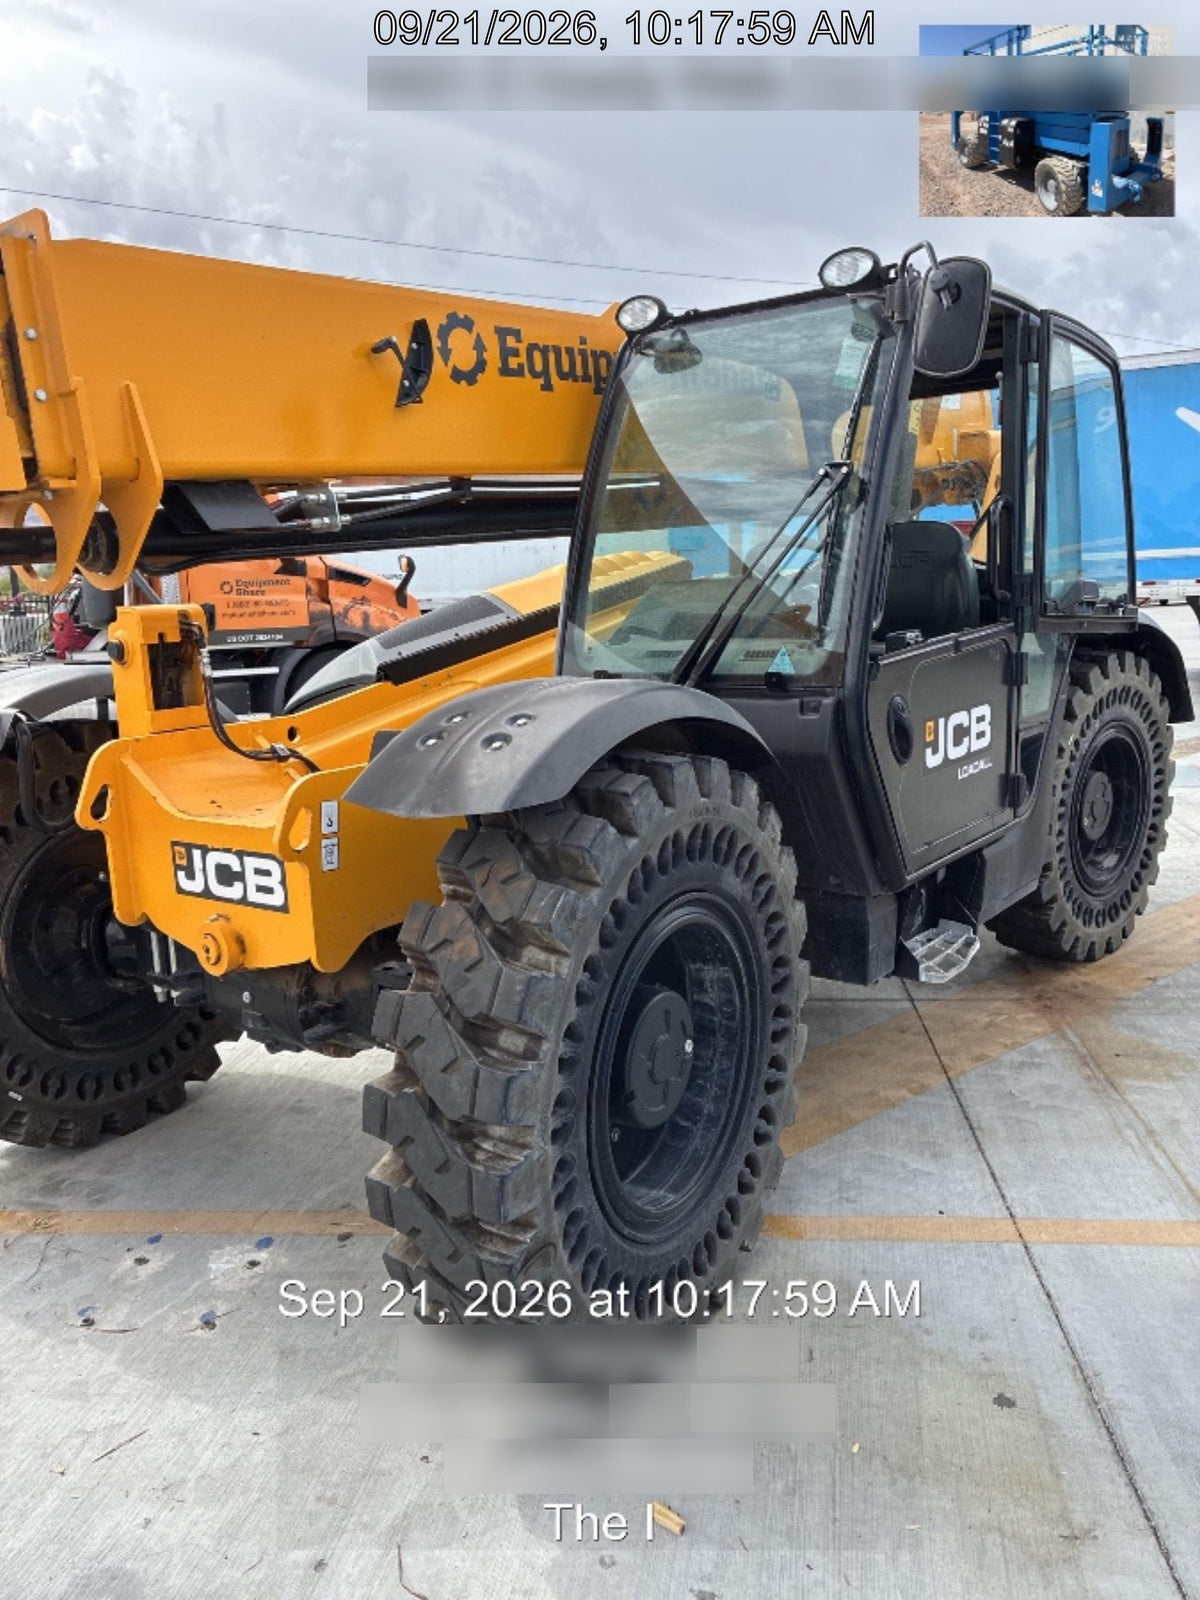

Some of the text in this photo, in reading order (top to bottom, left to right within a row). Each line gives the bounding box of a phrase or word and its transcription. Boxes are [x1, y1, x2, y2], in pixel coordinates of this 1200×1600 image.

[494, 325, 616, 395] Equip
[235, 578, 291, 589] Equipment
[235, 588, 266, 596] Share
[925, 703, 992, 769] JCB
[176, 848, 286, 907] JCB
